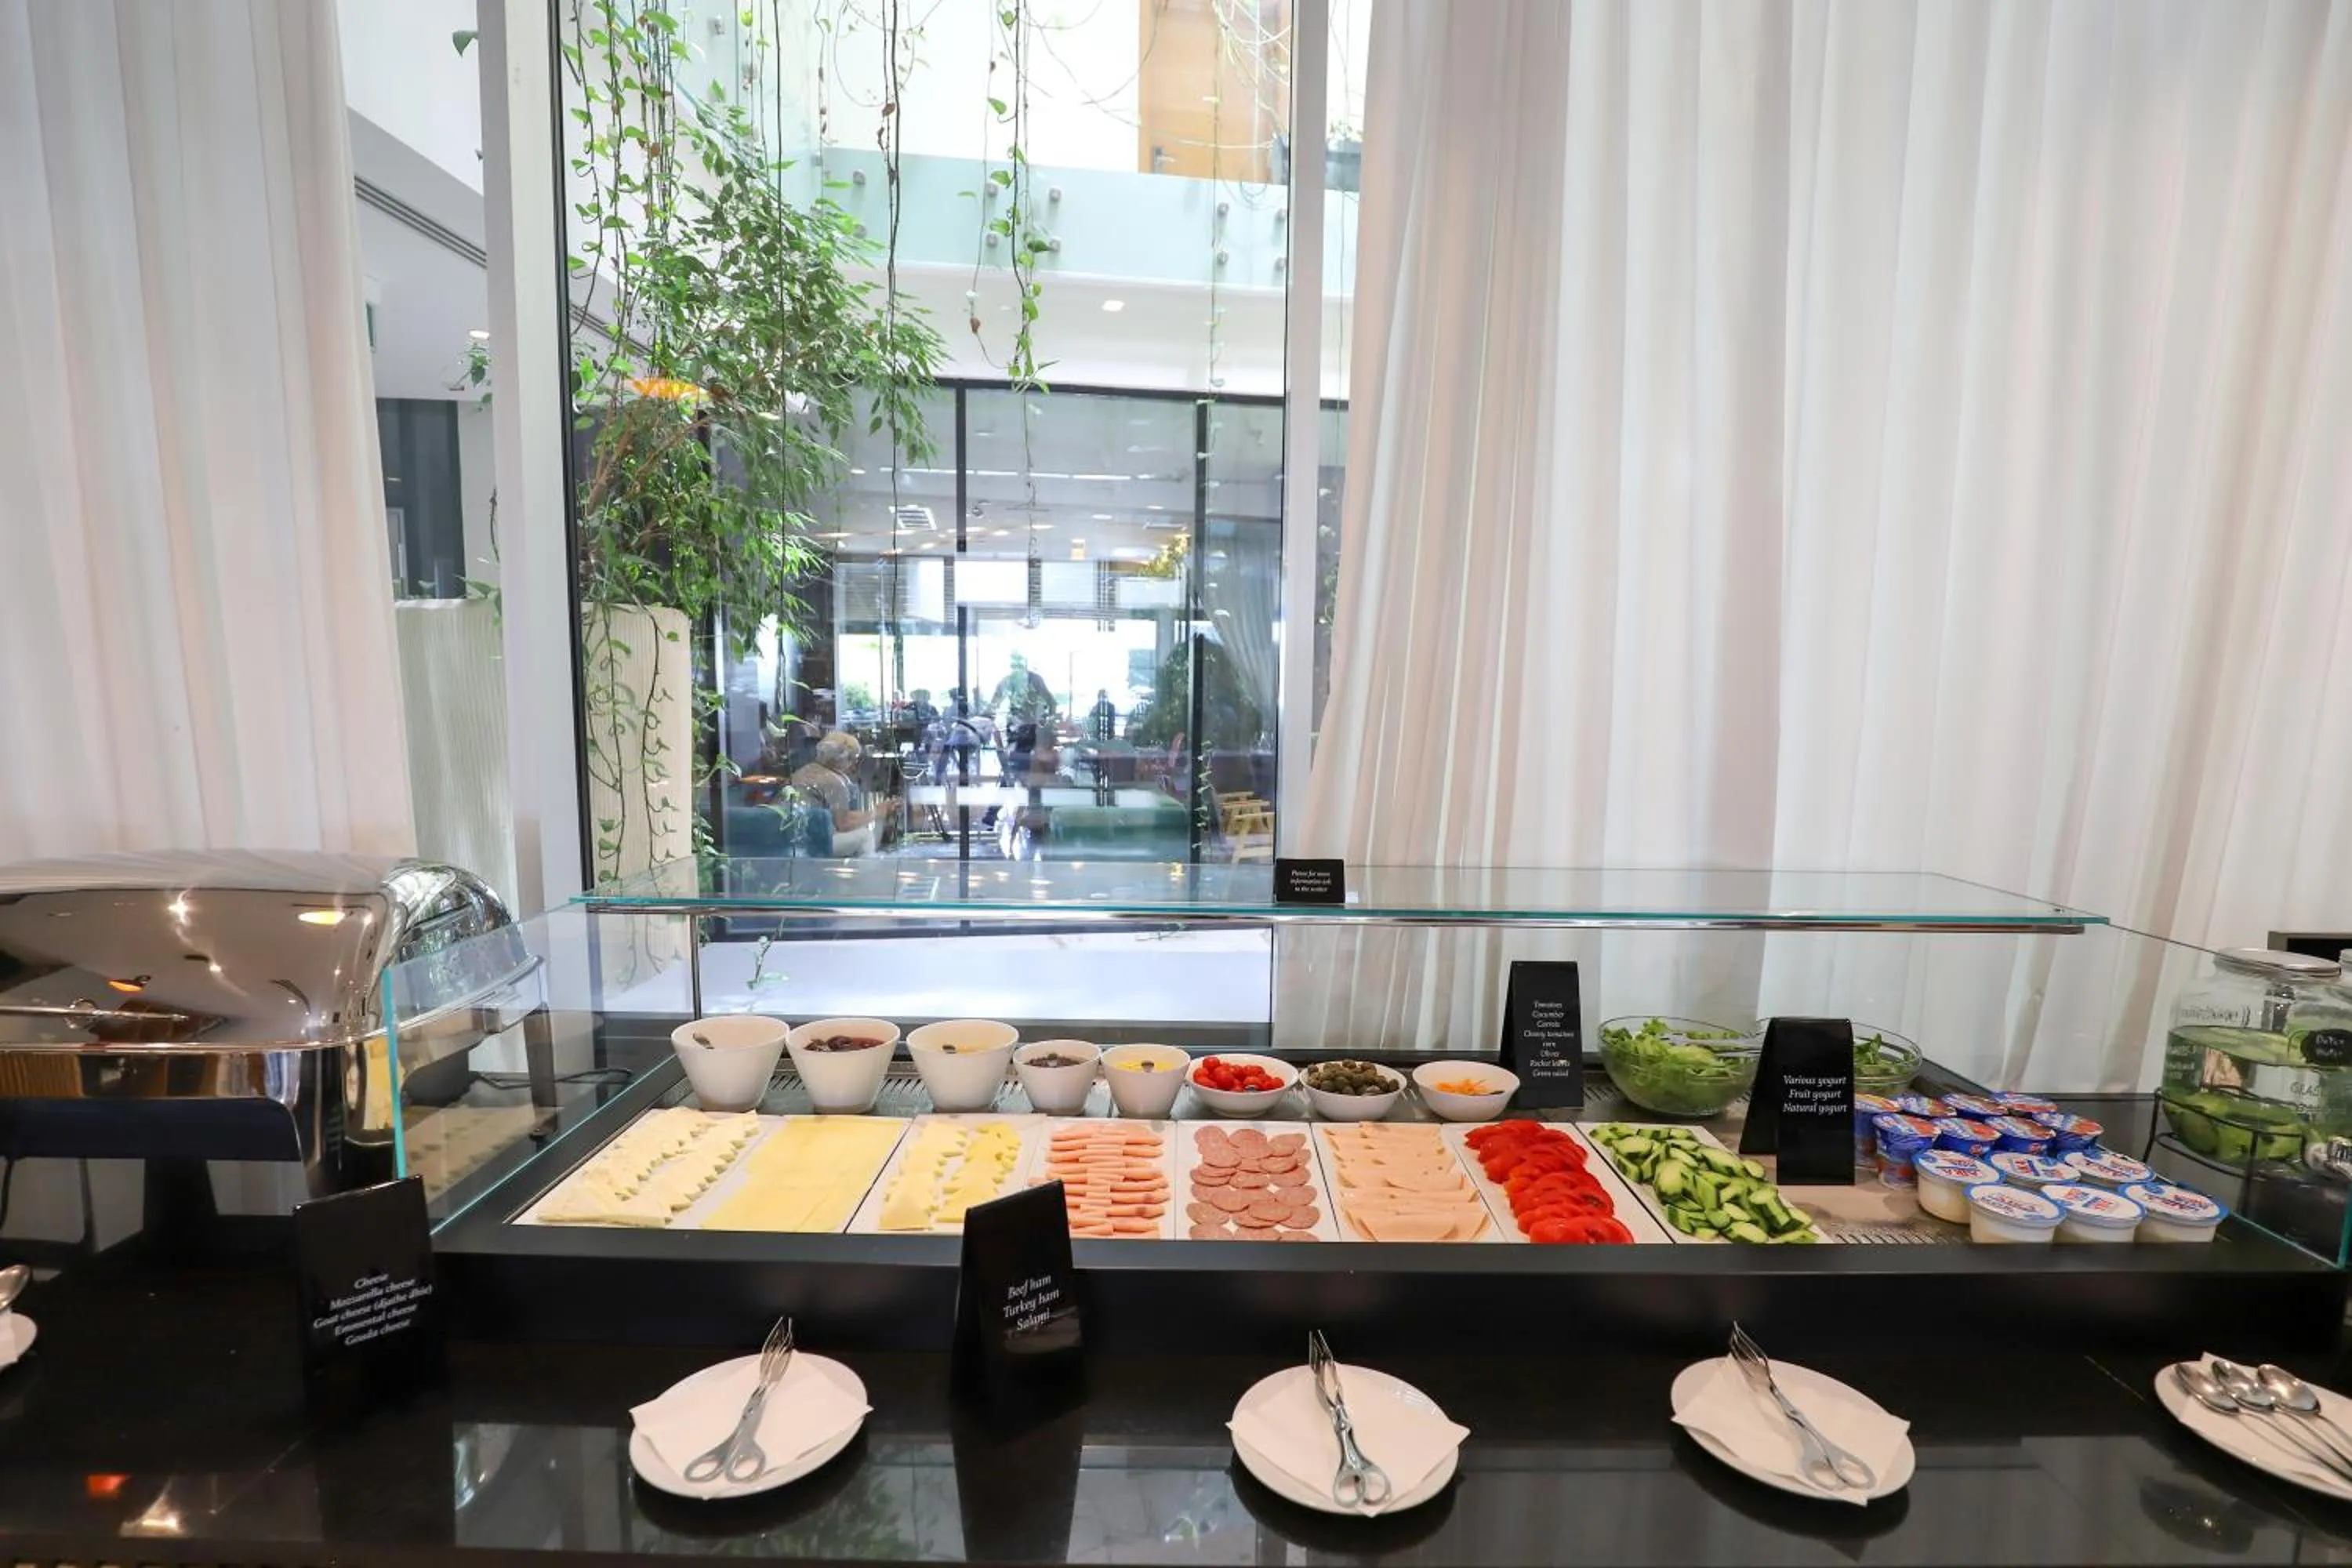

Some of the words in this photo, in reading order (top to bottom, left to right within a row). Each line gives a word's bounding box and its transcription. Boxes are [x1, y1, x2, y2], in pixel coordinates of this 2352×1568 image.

[1783, 1075, 1816, 1084] Various
[1817, 1076, 1846, 1087] yogurt
[1788, 1089, 1810, 1098] Fruit
[1812, 1090, 1842, 1101] yogurt
[1783, 1102, 1817, 1112] Natural
[1818, 1104, 1847, 1116] yogurt
[354, 1273, 390, 1290] Cheese
[385, 1279, 416, 1293] cheese
[1029, 1275, 1051, 1291] ham
[1004, 1299, 1036, 1318] Turkey
[1038, 1288, 1059, 1305] ham
[340, 1305, 372, 1320] cheese
[387, 1304, 418, 1319] cheese
[379, 1319, 412, 1334] cheese
[1017, 1308, 1050, 1331] Salami
